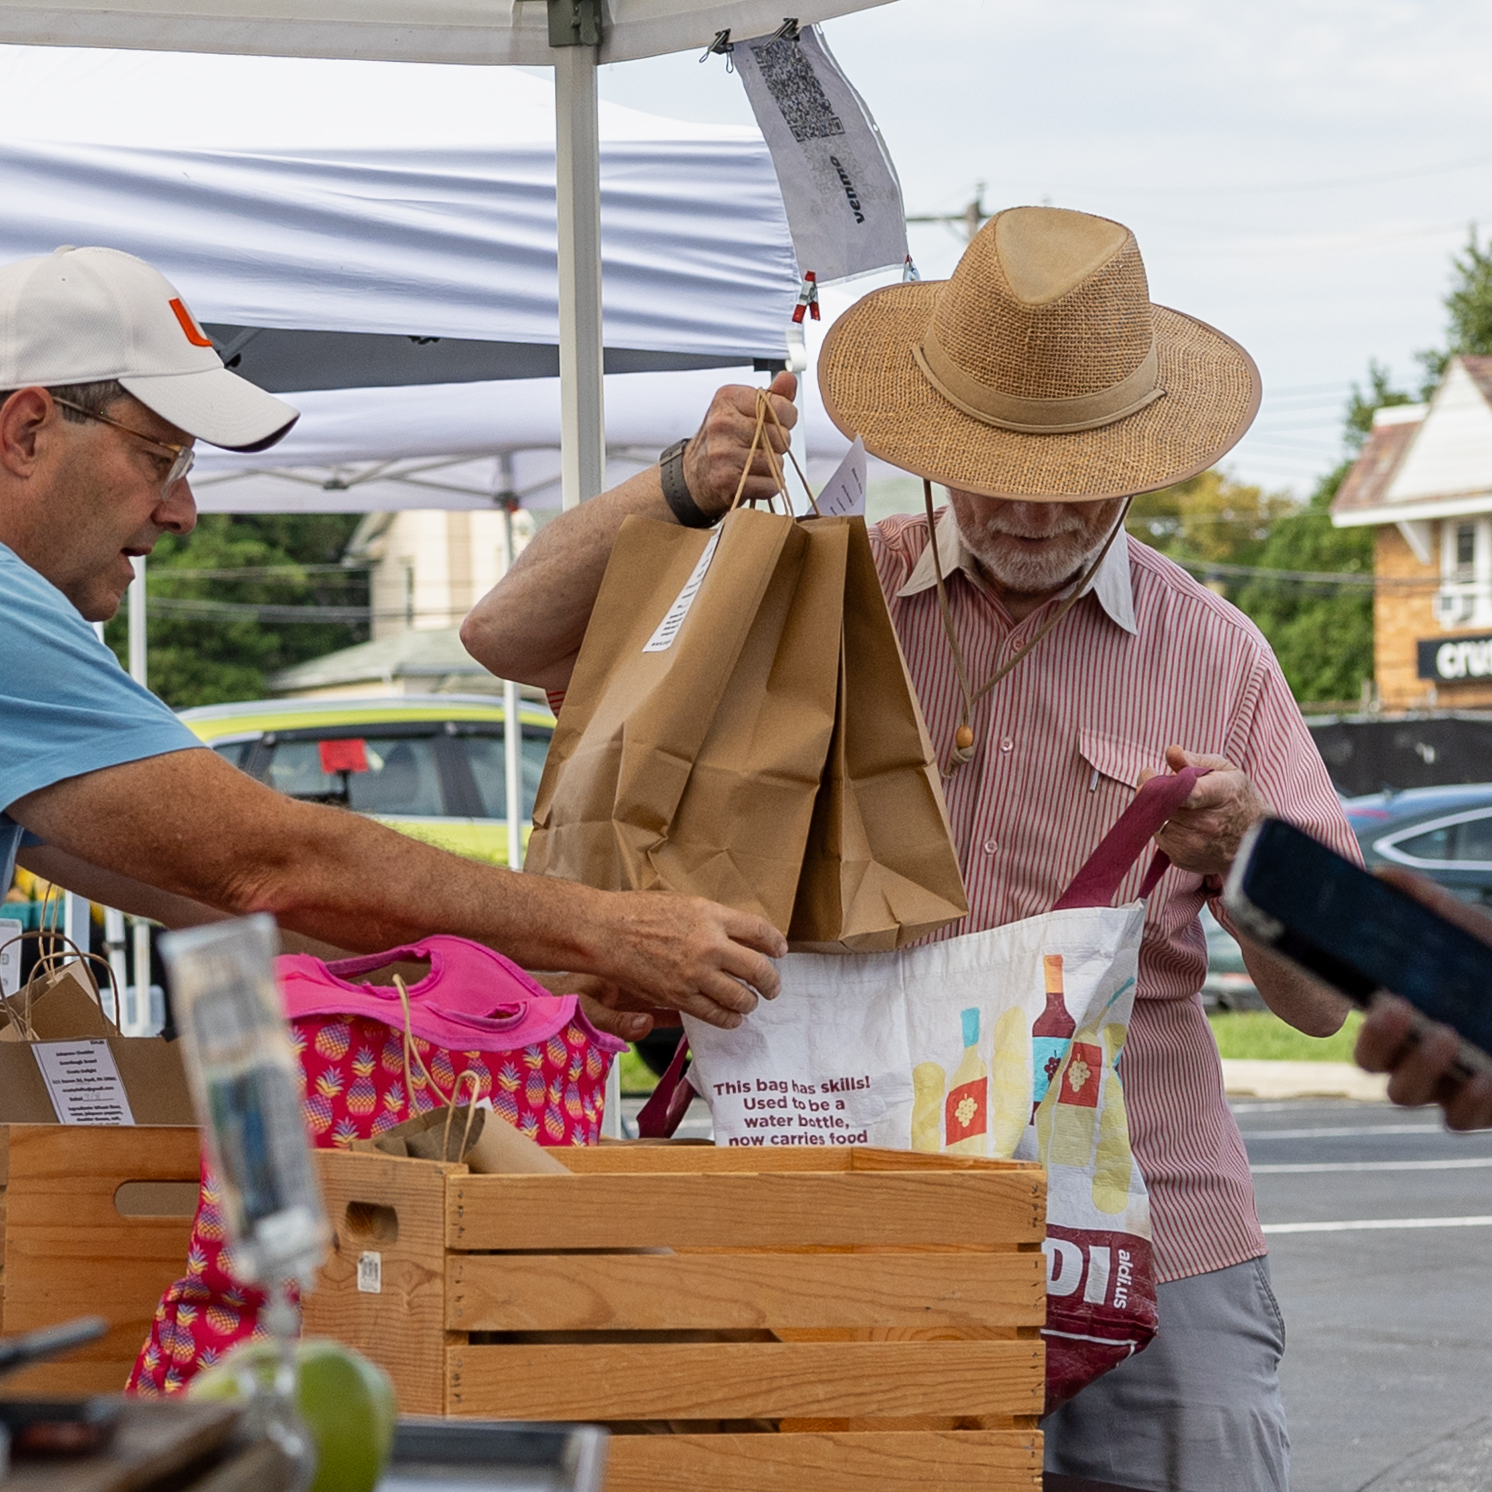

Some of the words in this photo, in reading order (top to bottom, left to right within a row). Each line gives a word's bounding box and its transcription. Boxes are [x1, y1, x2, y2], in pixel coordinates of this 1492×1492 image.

[830, 155, 865, 224] venmo
[713, 1081, 751, 1096] This
[756, 1078, 788, 1093] bag
[792, 1079, 816, 1094] has
[820, 1075, 871, 1093] skills!
[743, 1096, 788, 1110] Used
[792, 1097, 806, 1110] to
[808, 1099, 830, 1112] be
[835, 1100, 846, 1110] a
[744, 1115, 794, 1128] water
[798, 1114, 850, 1130] bottle,
[729, 1135, 765, 1146] now
[770, 1131, 825, 1145] carries
[829, 1130, 868, 1145] food
[1113, 1249, 1134, 1309] aldi.us
